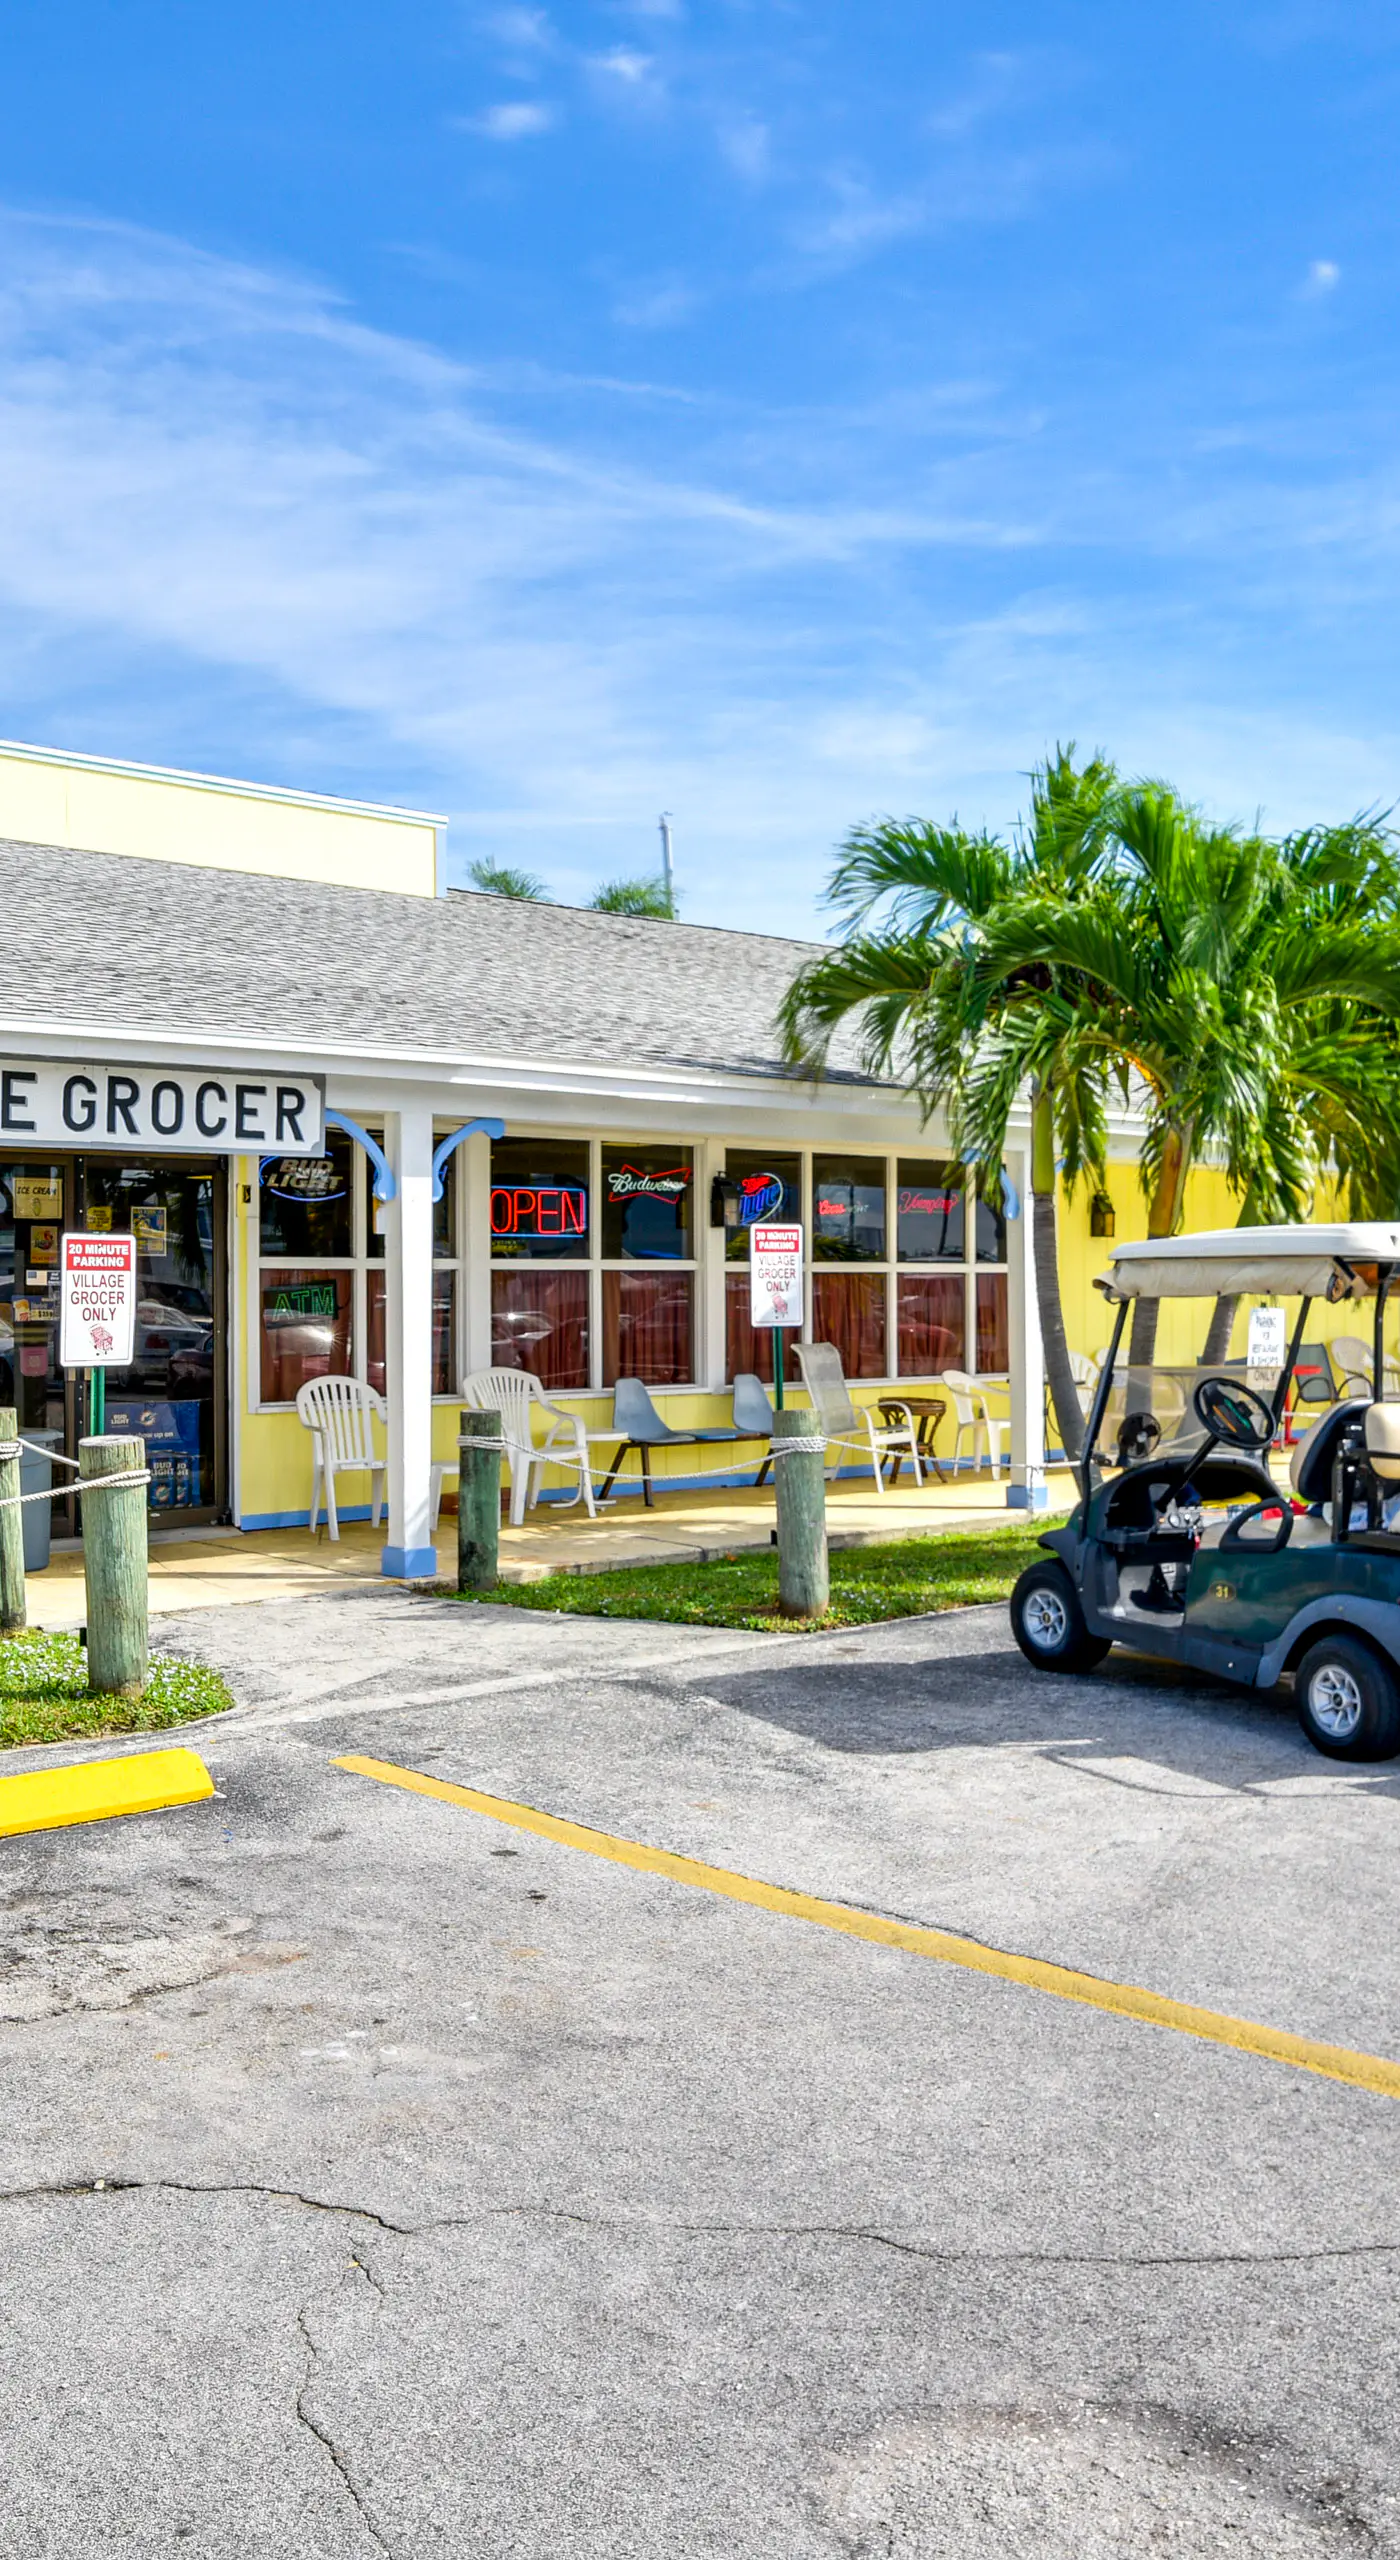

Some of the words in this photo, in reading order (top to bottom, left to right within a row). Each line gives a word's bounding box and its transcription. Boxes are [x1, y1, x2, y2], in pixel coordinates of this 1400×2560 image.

[63, 1075, 306, 1142] GROCER
[280, 1159, 334, 1173] BUD
[266, 1173, 344, 1190] LIGHT
[17, 1186, 30, 1195] ICE
[490, 1189, 584, 1234] OPEN
[756, 1231, 766, 1240] 20
[767, 1231, 798, 1240] MINUTE
[68, 1243, 83, 1255] 20
[85, 1244, 129, 1255] MINUTE
[758, 1241, 796, 1250] PARKING
[73, 1256, 125, 1267] PARKING
[759, 1255, 796, 1266] VILLAGE
[758, 1268, 796, 1279] GROCER
[72, 1274, 125, 1288] VILLAGE
[766, 1281, 790, 1292] ONLY
[71, 1291, 125, 1305] GROCER
[272, 1286, 334, 1322] ATM
[82, 1308, 116, 1322] ONLY
[1215, 1585, 1229, 1599] 31
